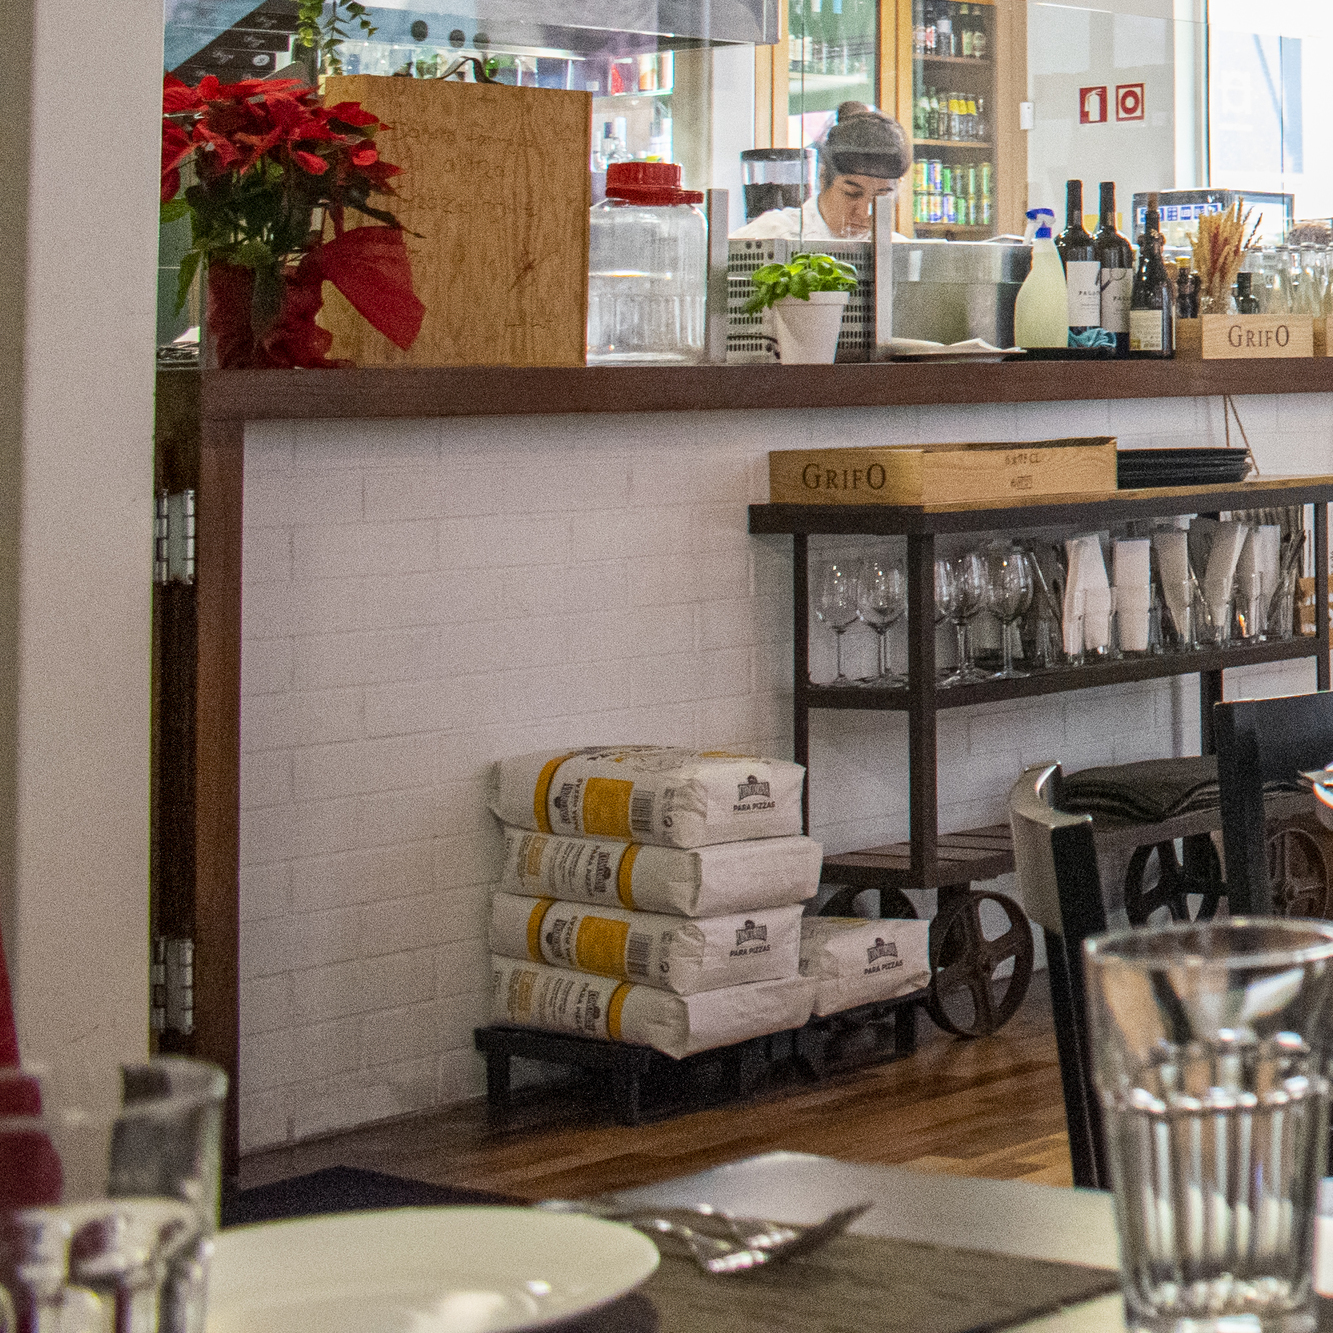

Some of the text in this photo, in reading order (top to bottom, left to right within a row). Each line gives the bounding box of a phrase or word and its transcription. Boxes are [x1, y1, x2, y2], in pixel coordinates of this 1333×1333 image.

[732, 800, 776, 813] PARA PIZZAS
[729, 944, 771, 958] PARA PIZZAS
[863, 959, 904, 975] PARA PIZZAS
